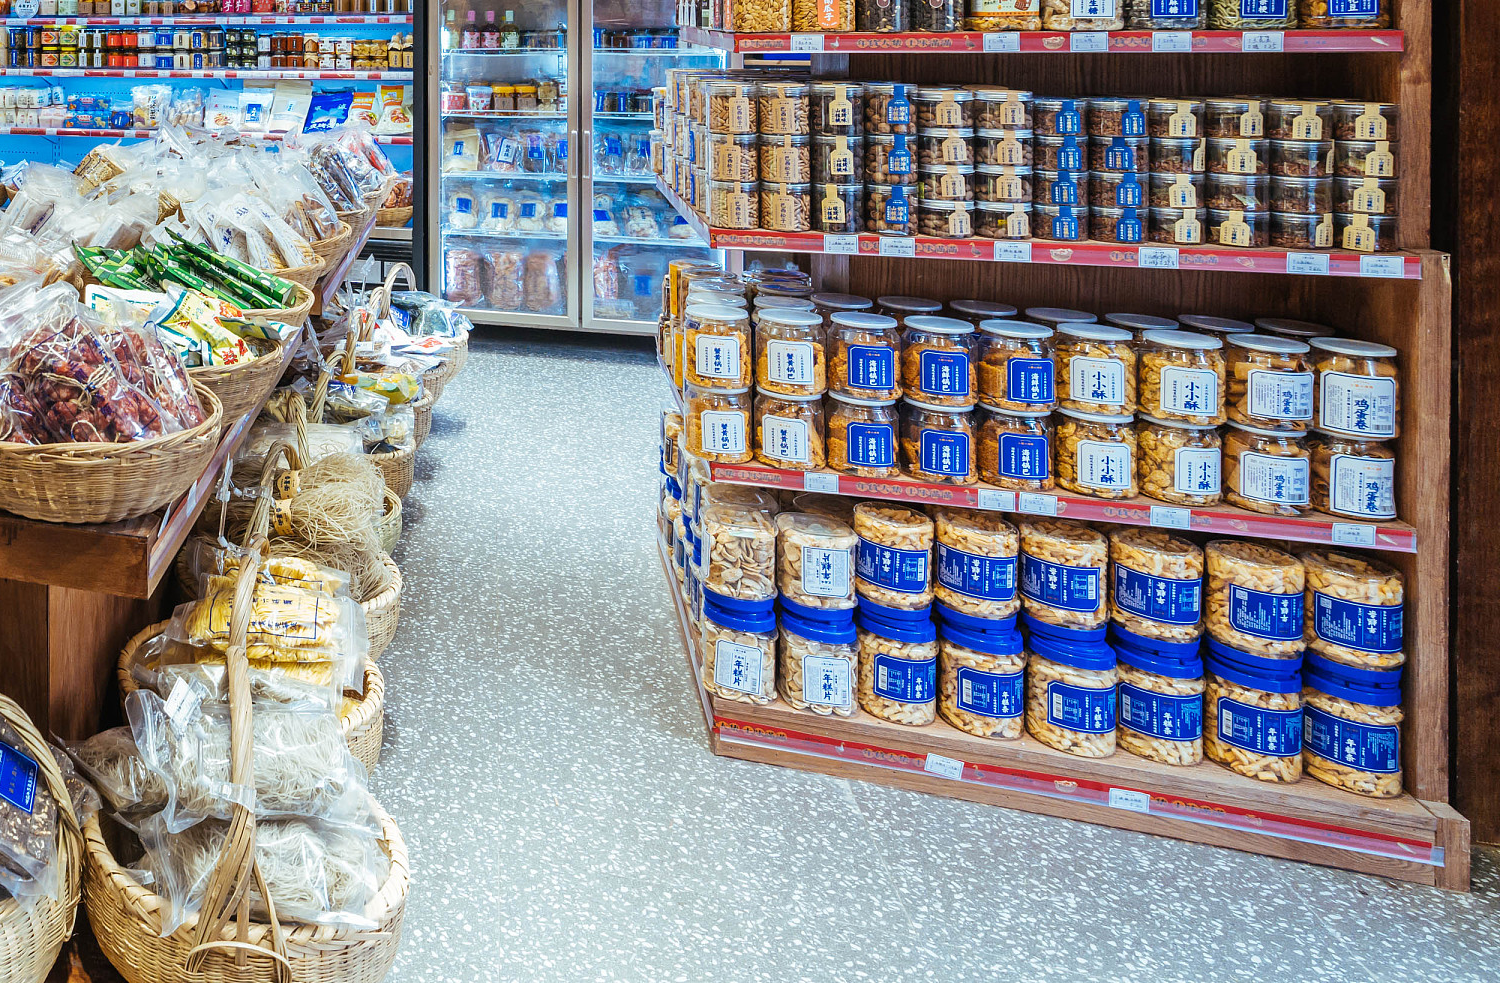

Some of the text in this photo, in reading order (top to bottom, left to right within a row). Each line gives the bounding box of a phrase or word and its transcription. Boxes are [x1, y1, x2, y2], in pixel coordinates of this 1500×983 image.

[1091, 371, 1107, 400] 小小酥
[1184, 382, 1200, 411] 小小酥
[1282, 390, 1293, 415] 鸡蛋卷
[1354, 398, 1370, 430] 鸡蛋卷
[1101, 456, 1116, 484] 小小酥
[1198, 462, 1211, 490] 小小酥
[1275, 475, 1285, 499] 鸡蛋卷
[1366, 481, 1379, 512] 鸡蛋卷
[821, 552, 831, 580] 年糕片
[733, 659, 744, 687] 年糕片
[823, 674, 833, 701] 年糕片
